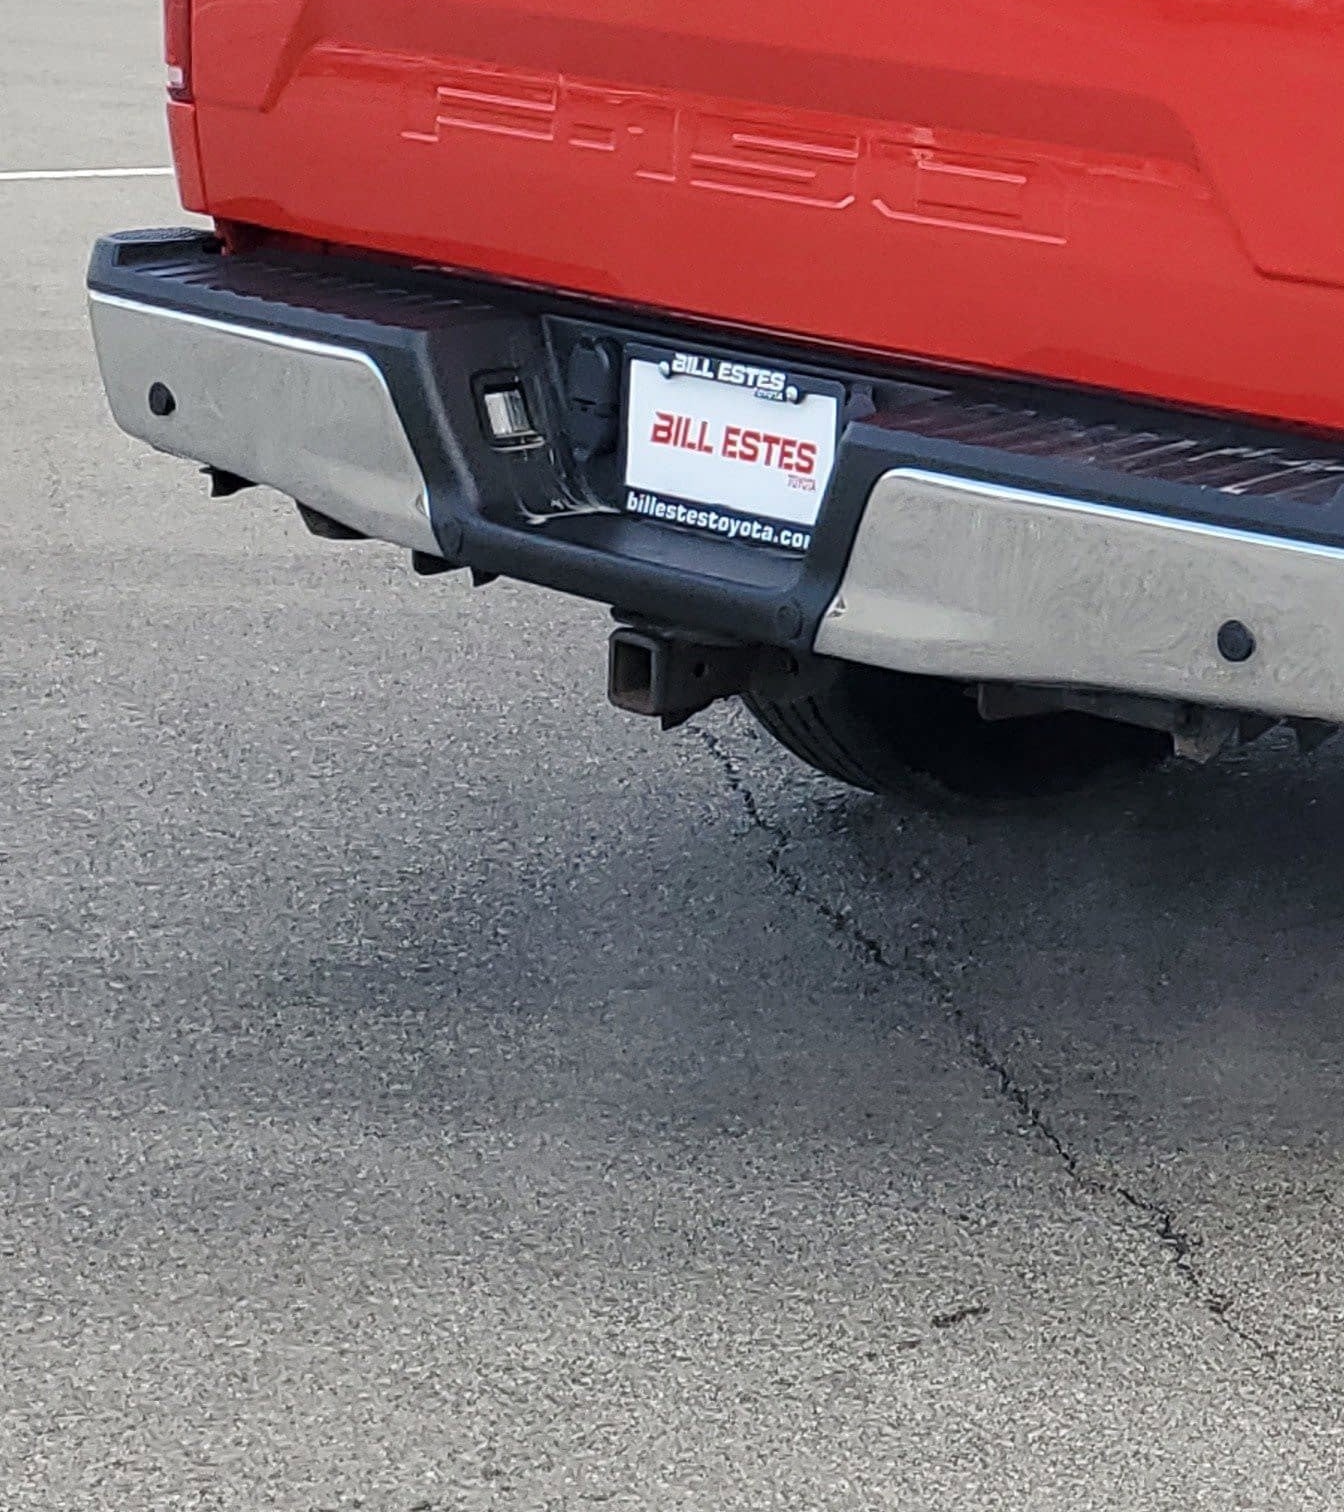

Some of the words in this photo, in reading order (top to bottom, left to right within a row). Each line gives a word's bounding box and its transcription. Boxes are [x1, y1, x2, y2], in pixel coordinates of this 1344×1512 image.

[671, 352, 713, 379] BILL
[718, 361, 786, 389] ESTES
[651, 411, 713, 454] BILL
[722, 426, 817, 474] ESTES
